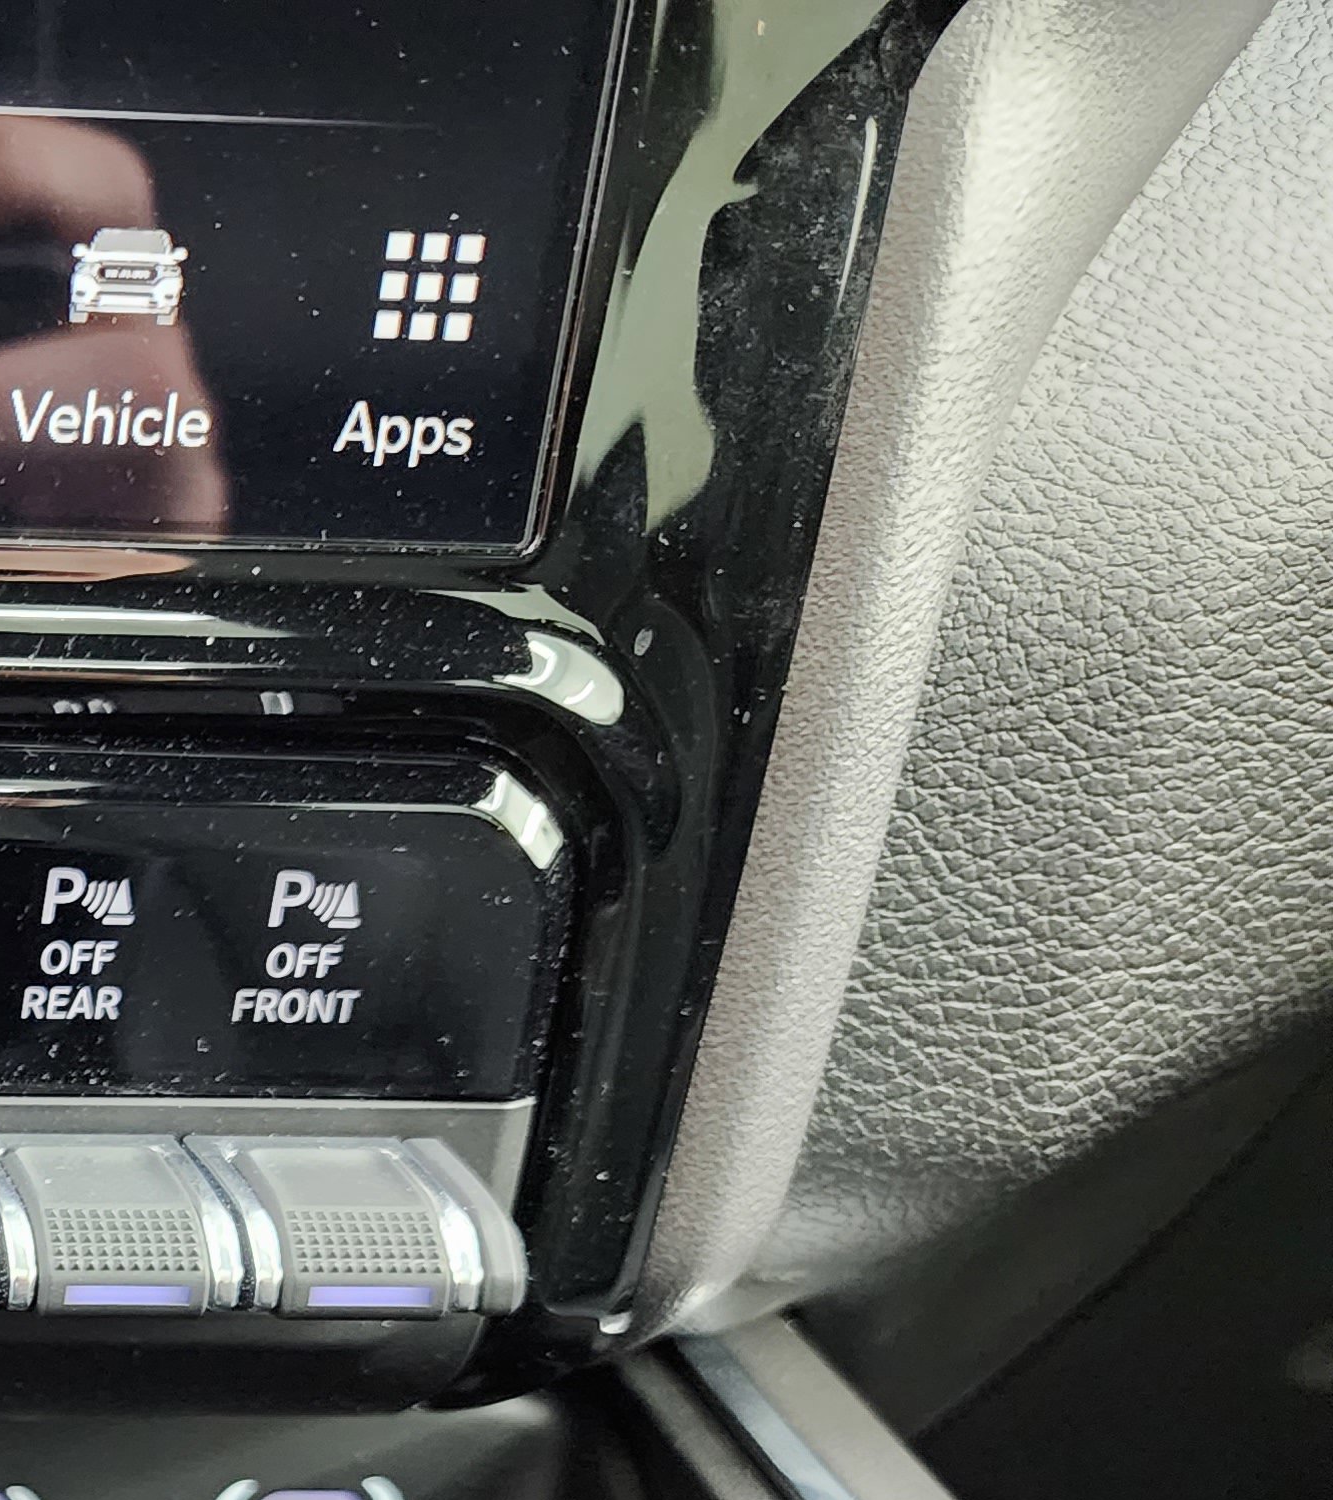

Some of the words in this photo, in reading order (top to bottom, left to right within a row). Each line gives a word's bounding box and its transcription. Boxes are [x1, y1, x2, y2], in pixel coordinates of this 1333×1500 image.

[11, 388, 211, 448] Vehicle
[333, 400, 474, 468] Apps
[40, 940, 118, 976] OFF
[265, 943, 343, 979] OFF
[20, 986, 122, 1020] REAR
[231, 989, 361, 1024] FRONT
